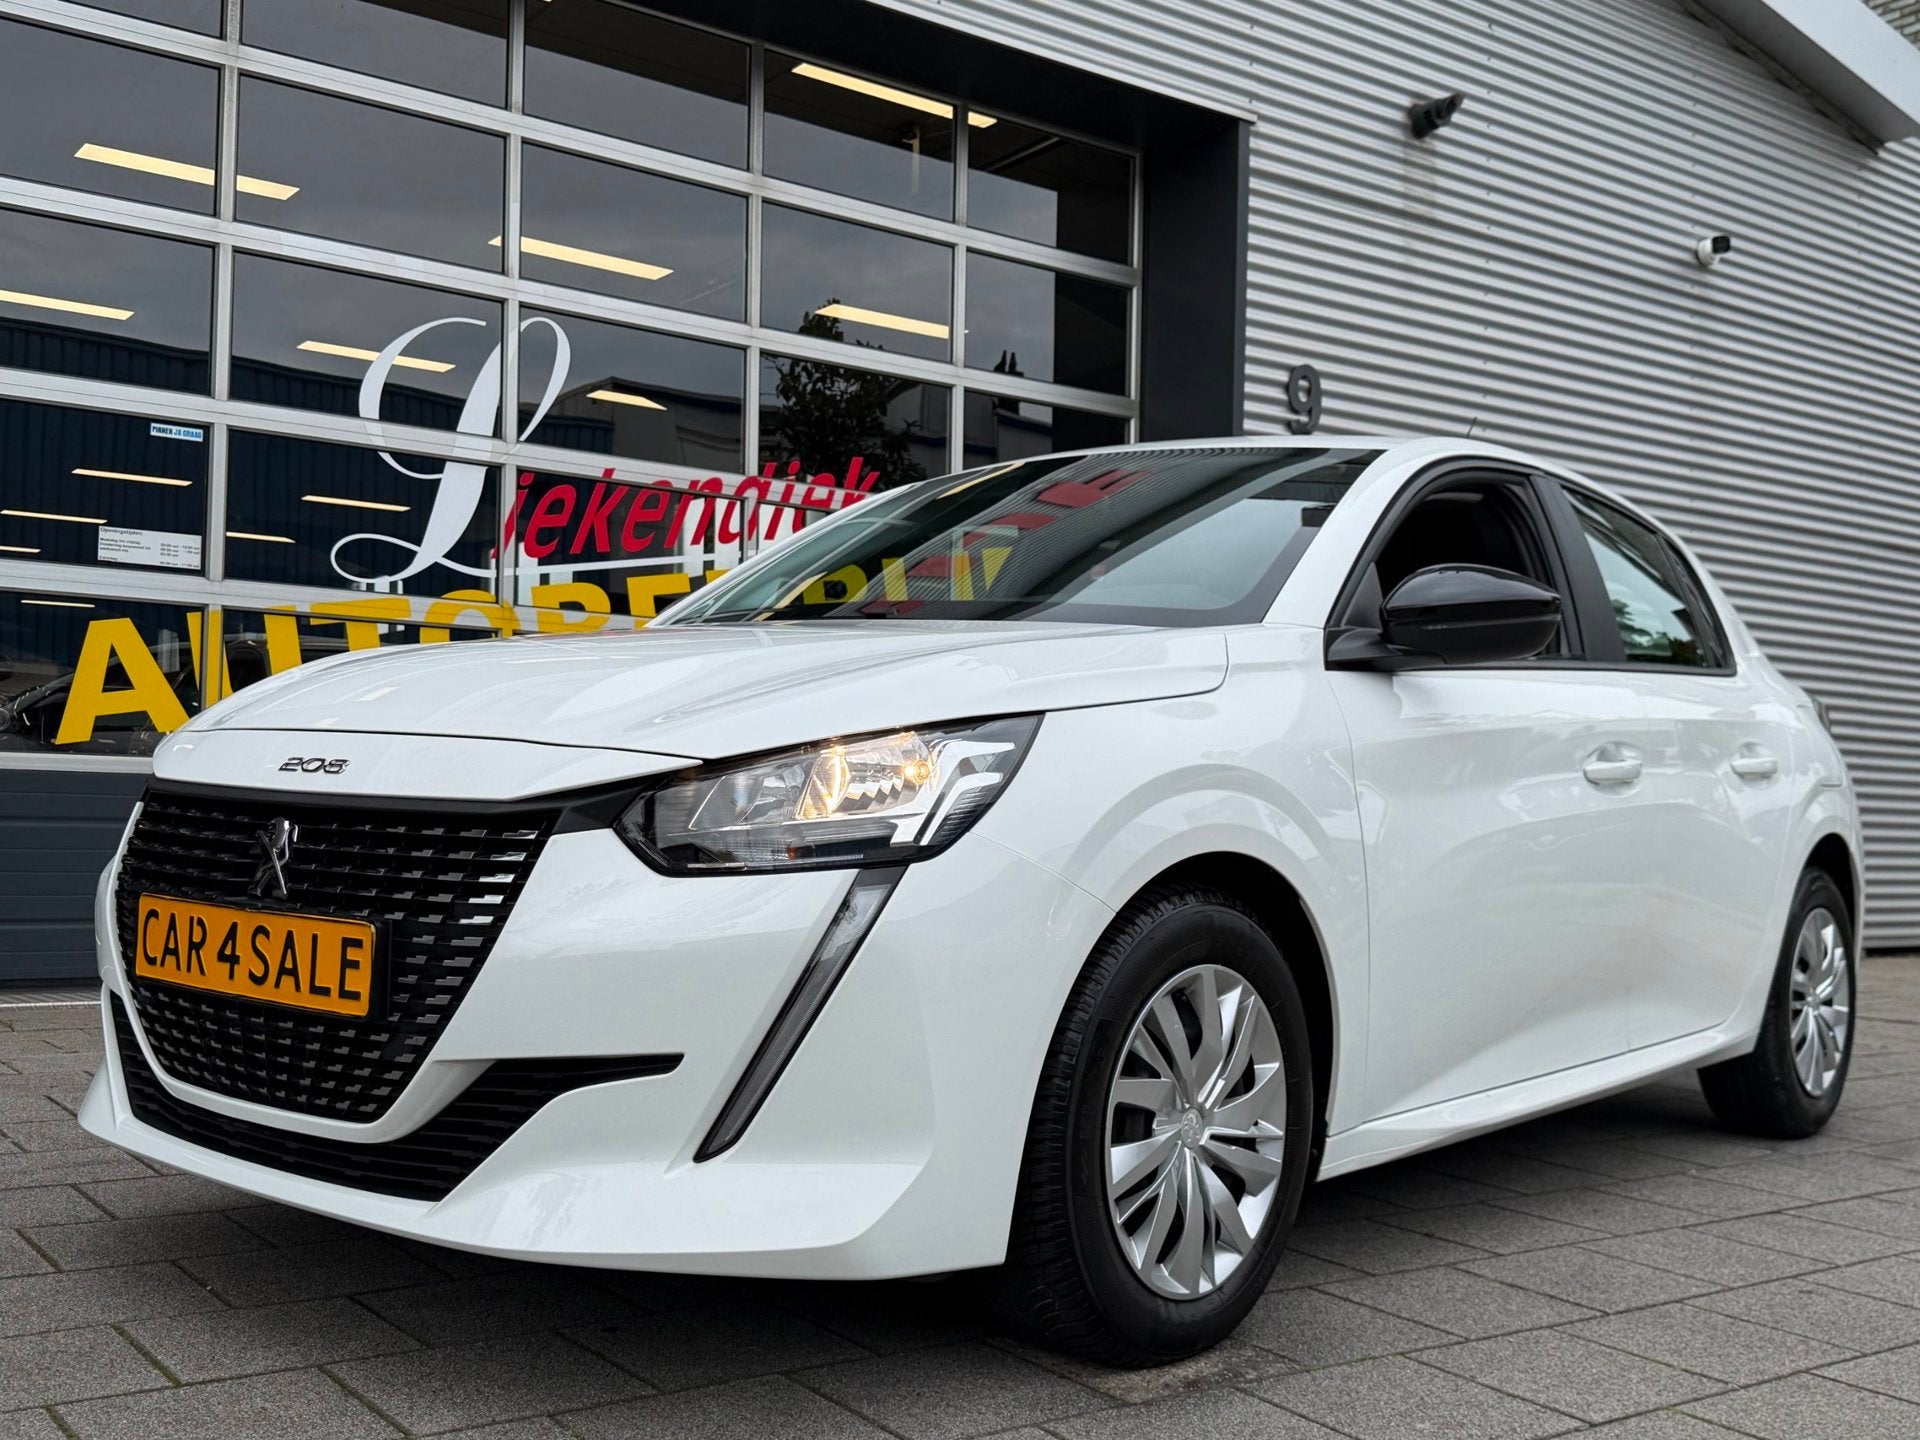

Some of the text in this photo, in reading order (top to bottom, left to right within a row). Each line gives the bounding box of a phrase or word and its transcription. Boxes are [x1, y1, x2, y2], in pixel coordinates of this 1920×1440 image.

[1286, 364, 1321, 435] 9
[152, 426, 173, 435] PINNEN
[174, 428, 182, 436] JA
[278, 757, 351, 775] 208
